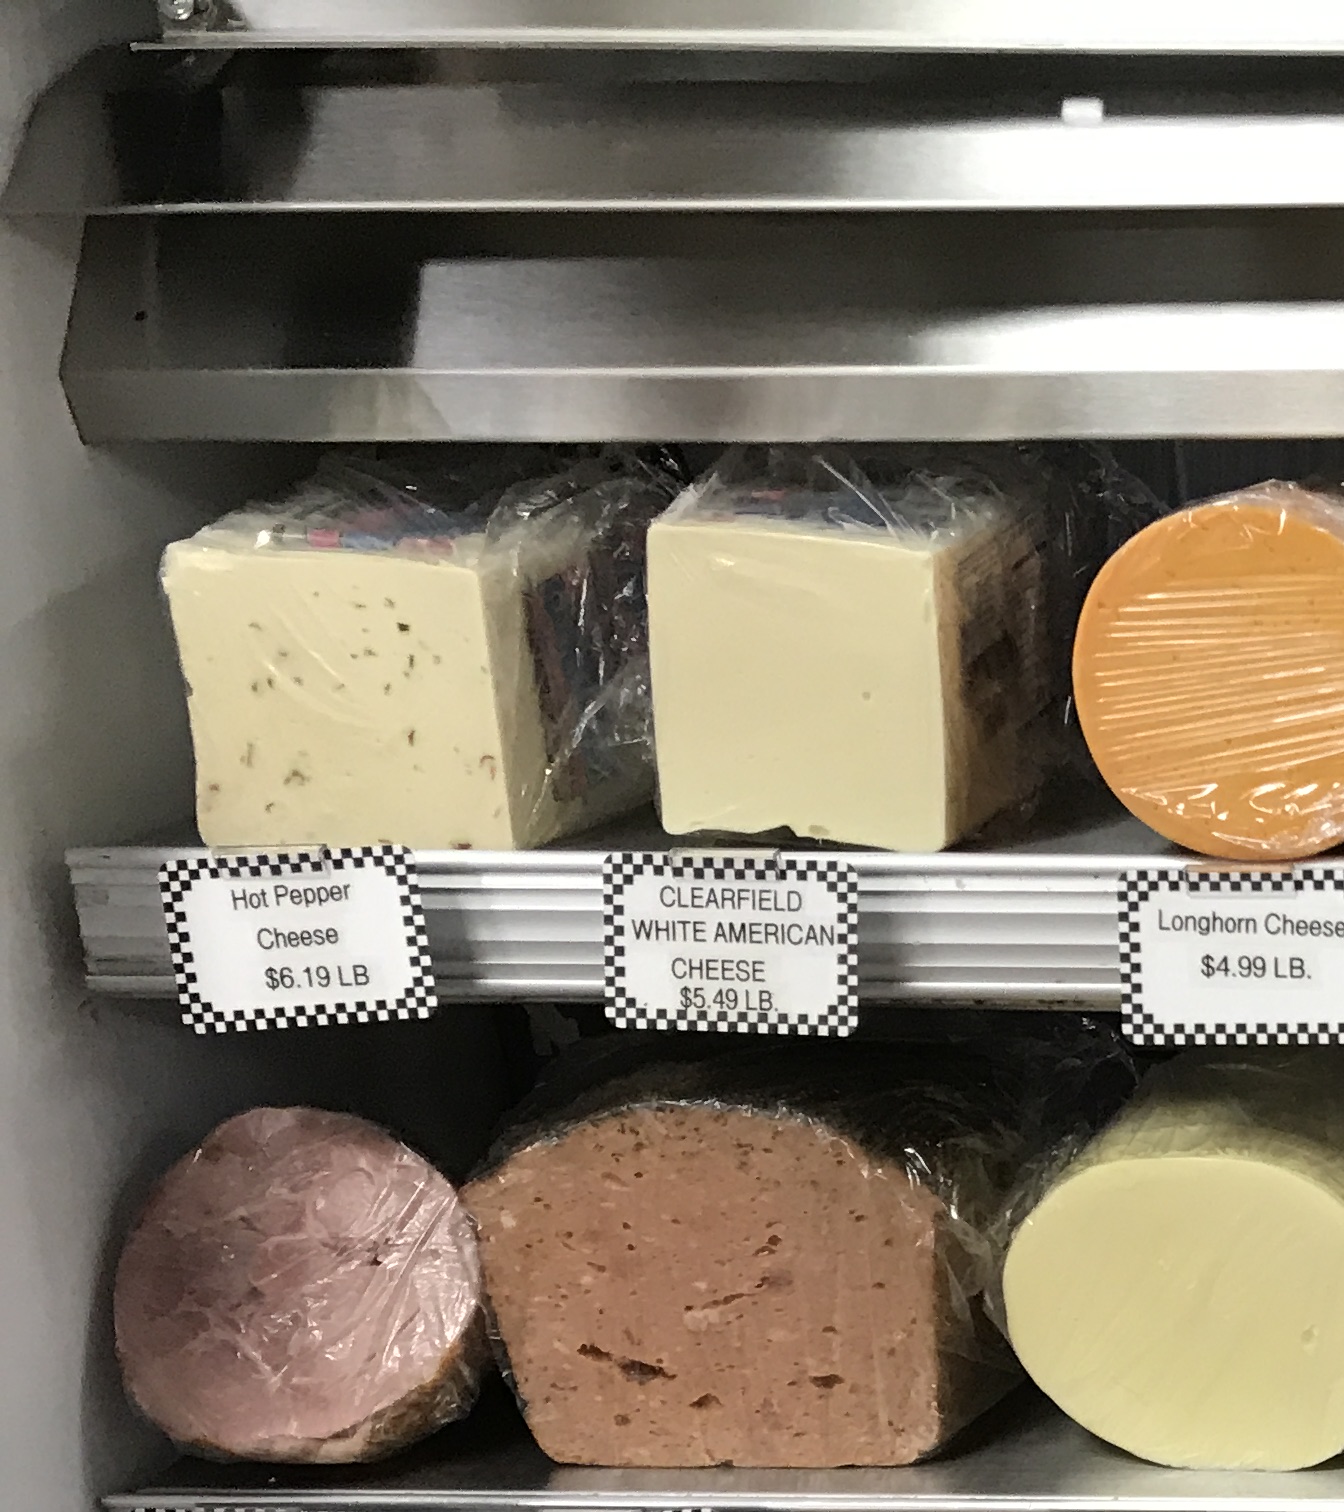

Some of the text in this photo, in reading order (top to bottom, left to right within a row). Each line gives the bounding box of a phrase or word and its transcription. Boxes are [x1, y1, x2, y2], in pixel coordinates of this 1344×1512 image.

[231, 883, 351, 911] Hot Pepper
[660, 885, 802, 912] CLEARFIELD
[632, 919, 835, 946] WHITE AMERICAN
[1158, 909, 1258, 936] Longhorn
[257, 927, 339, 950] Cheese
[265, 965, 370, 990] $6.19 LB
[671, 957, 766, 983] CHEESE
[1201, 954, 1312, 979] $4.99 LB.
[680, 986, 779, 1012] $5.49 LB.
